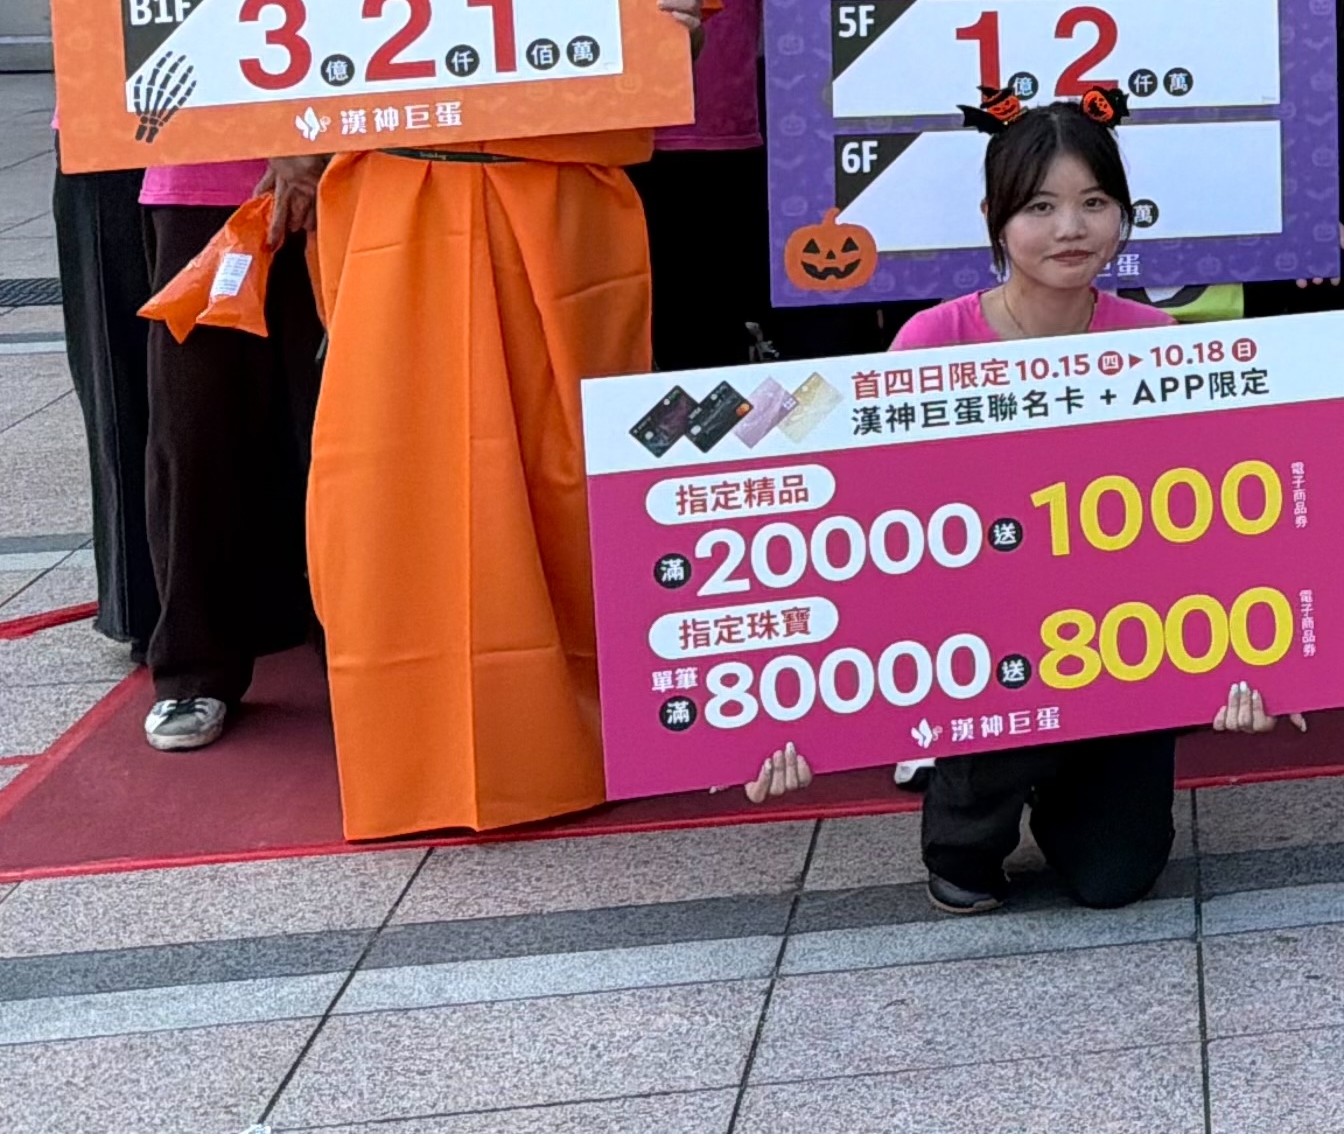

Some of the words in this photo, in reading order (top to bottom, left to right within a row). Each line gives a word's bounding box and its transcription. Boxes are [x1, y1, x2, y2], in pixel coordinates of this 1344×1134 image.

[837, 5, 875, 38] 5F
[340, 99, 463, 135] 漢神巨蛋
[841, 139, 879, 175] 6F
[851, 384, 1085, 437] 漢神巨蛋聯名卡
[676, 473, 809, 516] 指定精品
[1290, 461, 1308, 529] 電子商品券
[679, 606, 812, 650] 指定珠寶
[1299, 589, 1316, 657] 電子商品券
[651, 667, 699, 693] 單筆
[951, 706, 1060, 741] 漢神巨蛋
